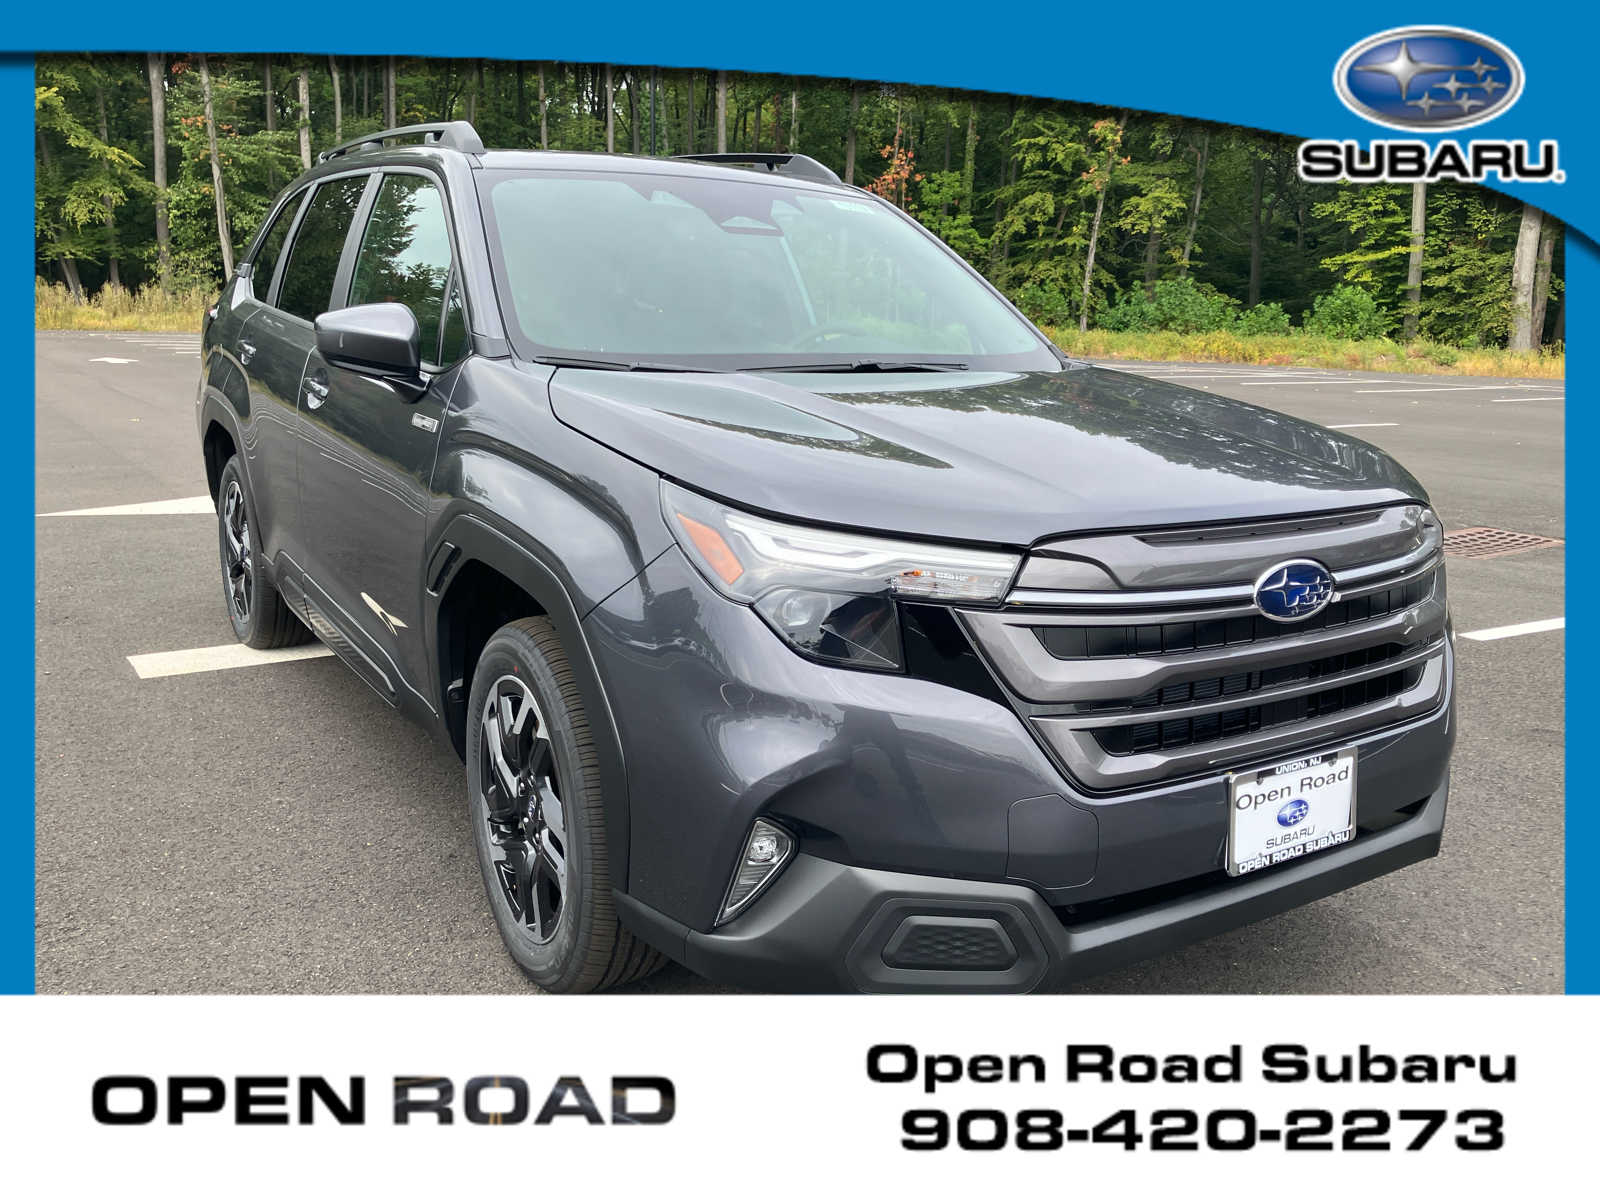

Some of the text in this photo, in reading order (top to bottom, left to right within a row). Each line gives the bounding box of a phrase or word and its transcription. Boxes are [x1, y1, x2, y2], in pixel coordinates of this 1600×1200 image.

[1309, 756, 1322, 767] NJ
[1236, 765, 1349, 811] Open Road
[1239, 830, 1350, 874] OPEN ROAD SUBARU
[1266, 825, 1316, 849] SUBARU
